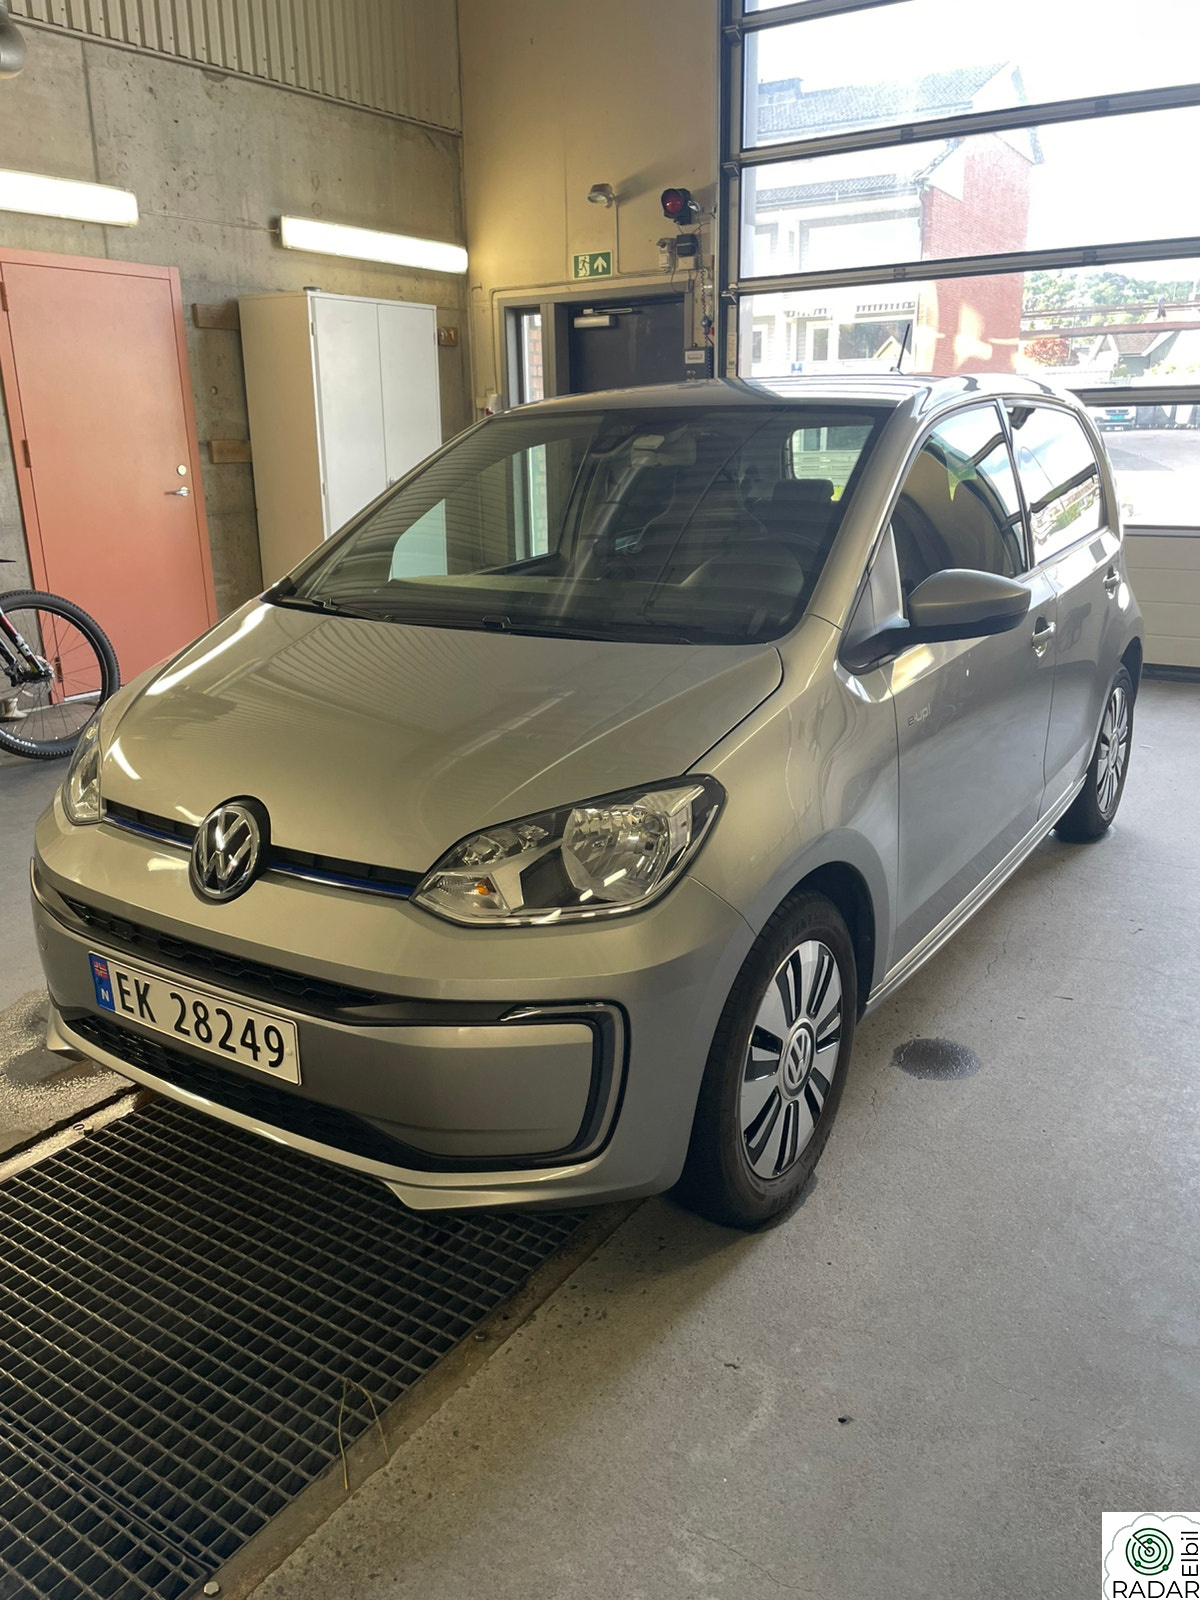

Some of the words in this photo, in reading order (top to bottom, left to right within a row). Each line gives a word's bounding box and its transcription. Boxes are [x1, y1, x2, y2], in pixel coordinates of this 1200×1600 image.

[101, 988, 110, 1002] N
[115, 971, 157, 1023] EK
[169, 992, 285, 1068] 28249
